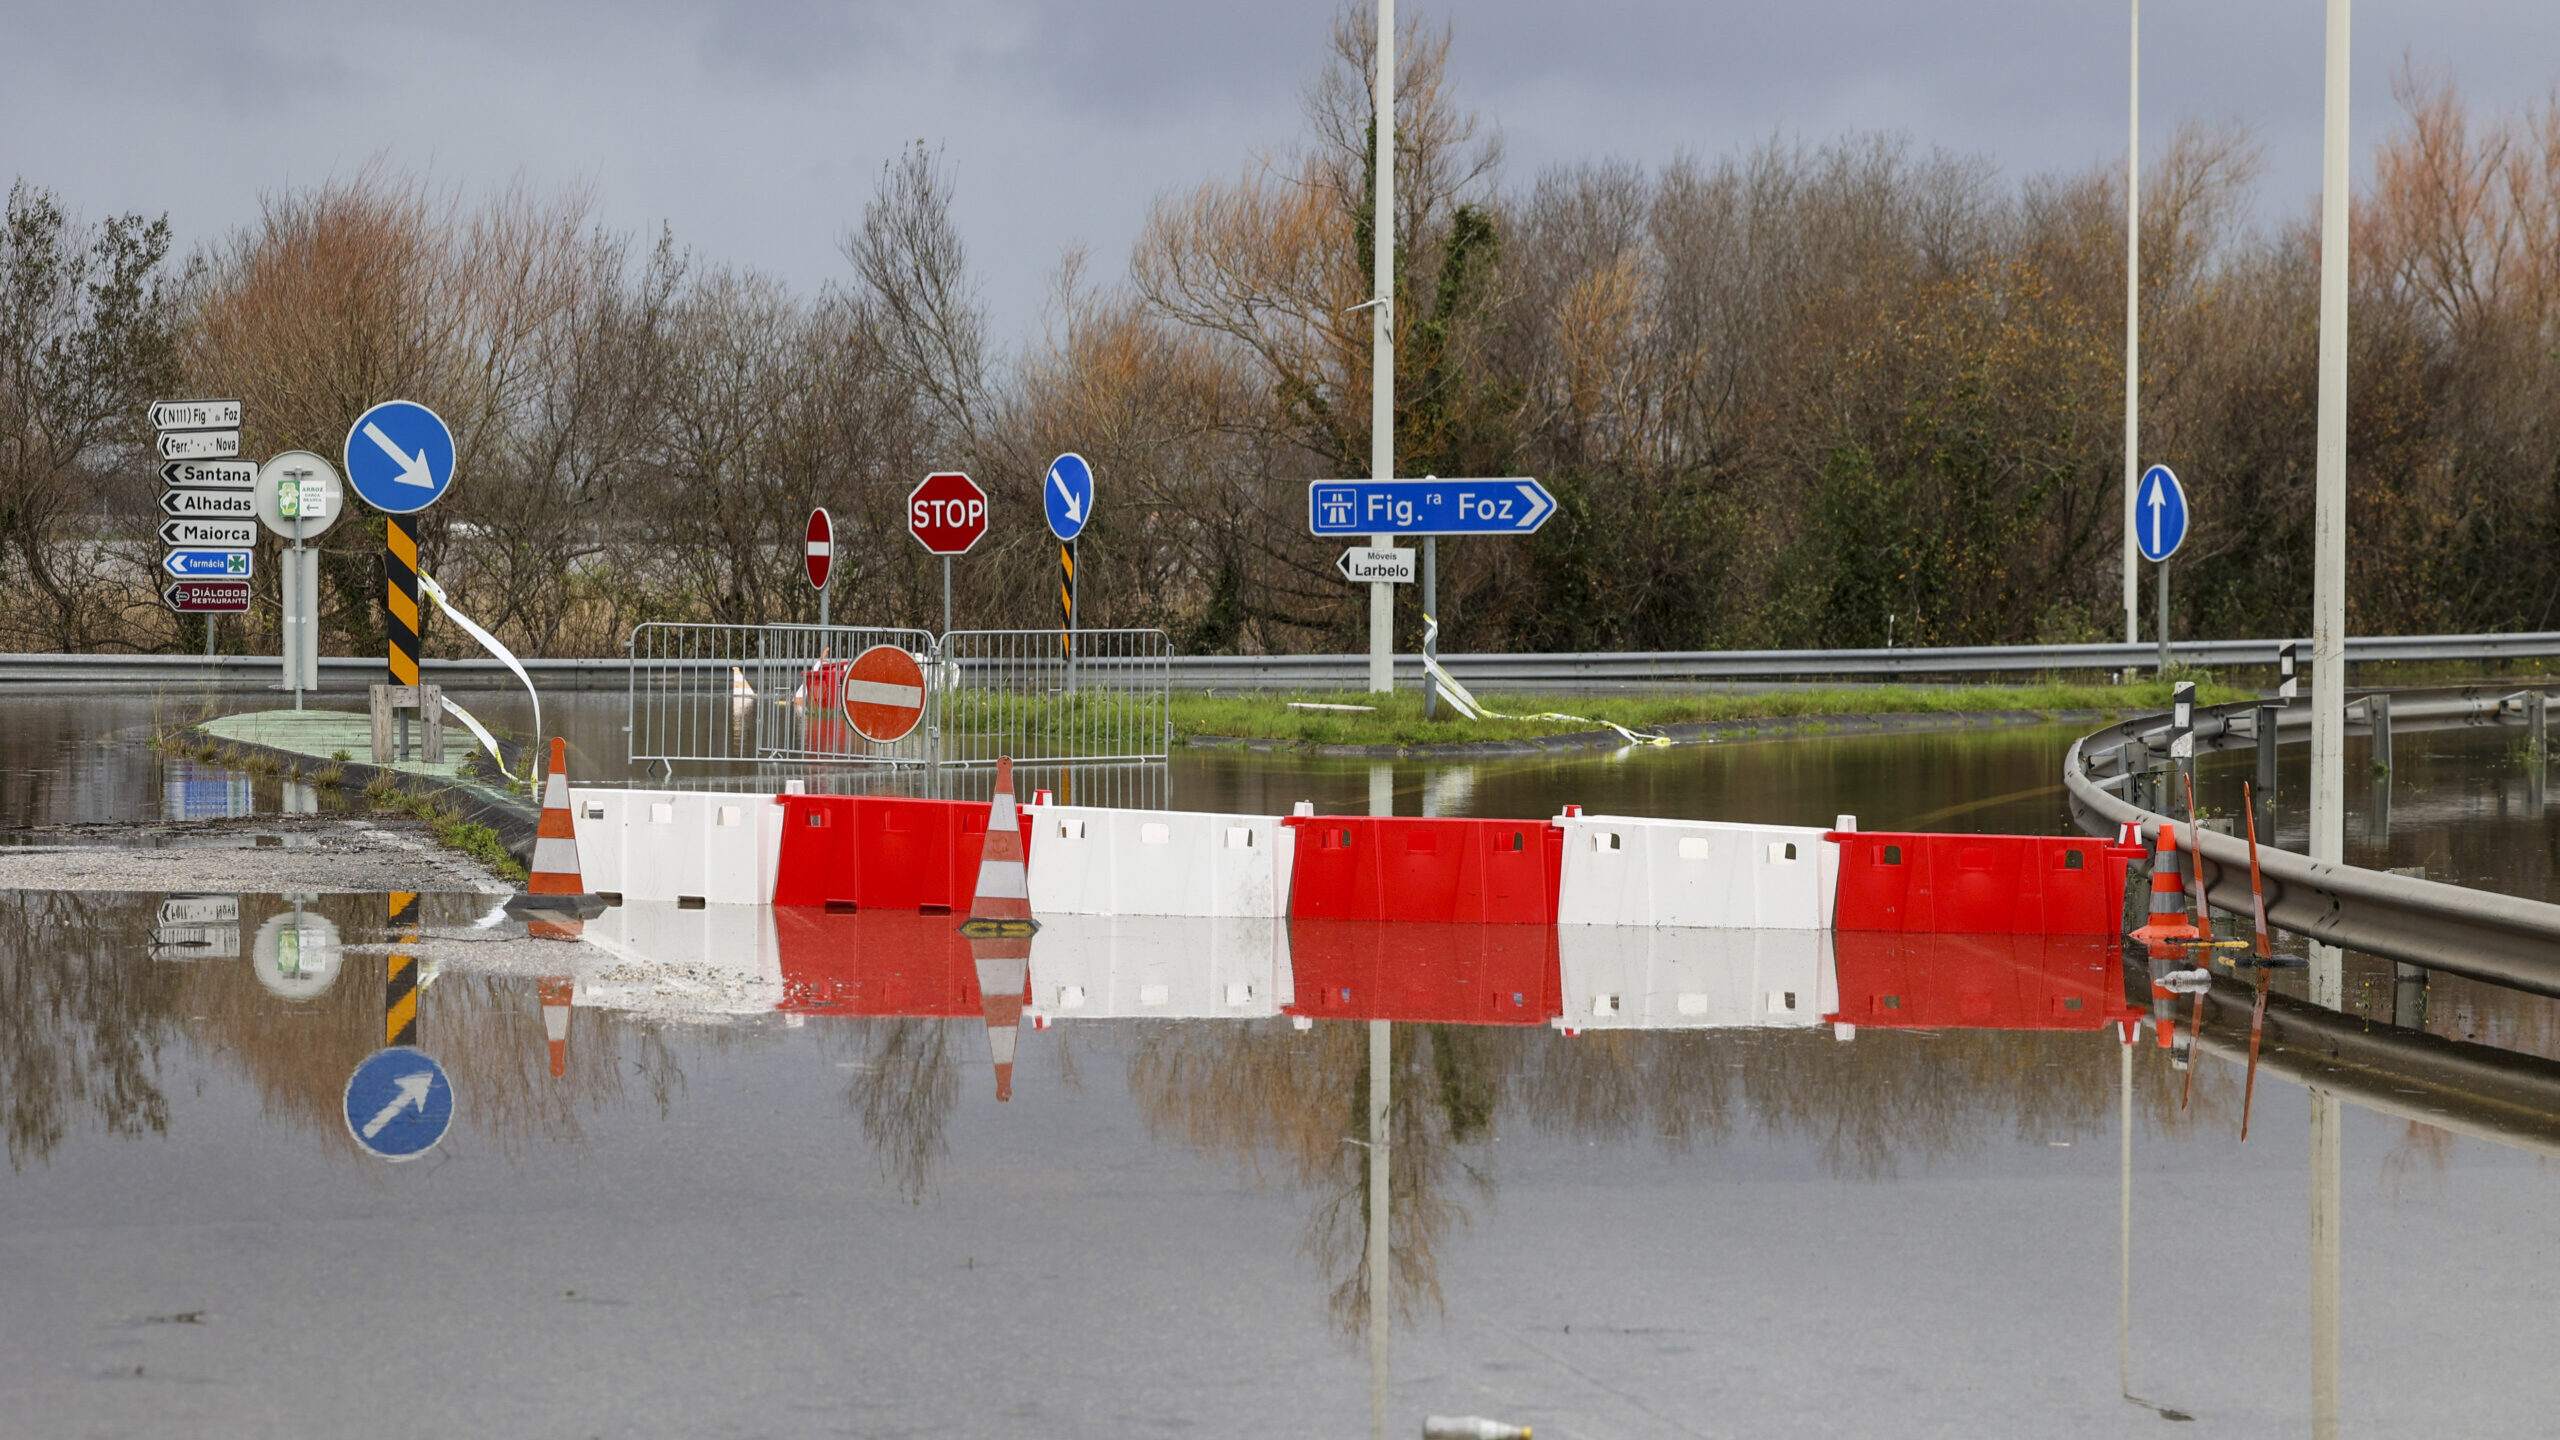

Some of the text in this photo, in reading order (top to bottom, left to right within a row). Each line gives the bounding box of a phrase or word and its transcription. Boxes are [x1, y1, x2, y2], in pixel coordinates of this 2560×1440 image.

[224, 407, 238, 421] Foz
[216, 437, 236, 452] Nova
[184, 466, 251, 481] Santana
[184, 496, 251, 511] Alhadas
[1459, 492, 1513, 520] Foz
[913, 498, 984, 528] STOP
[184, 526, 250, 540] Maiorca
[1367, 552, 1397, 560] Móveis
[189, 559, 225, 568] farmácia
[1355, 563, 1409, 577] Larbelo
